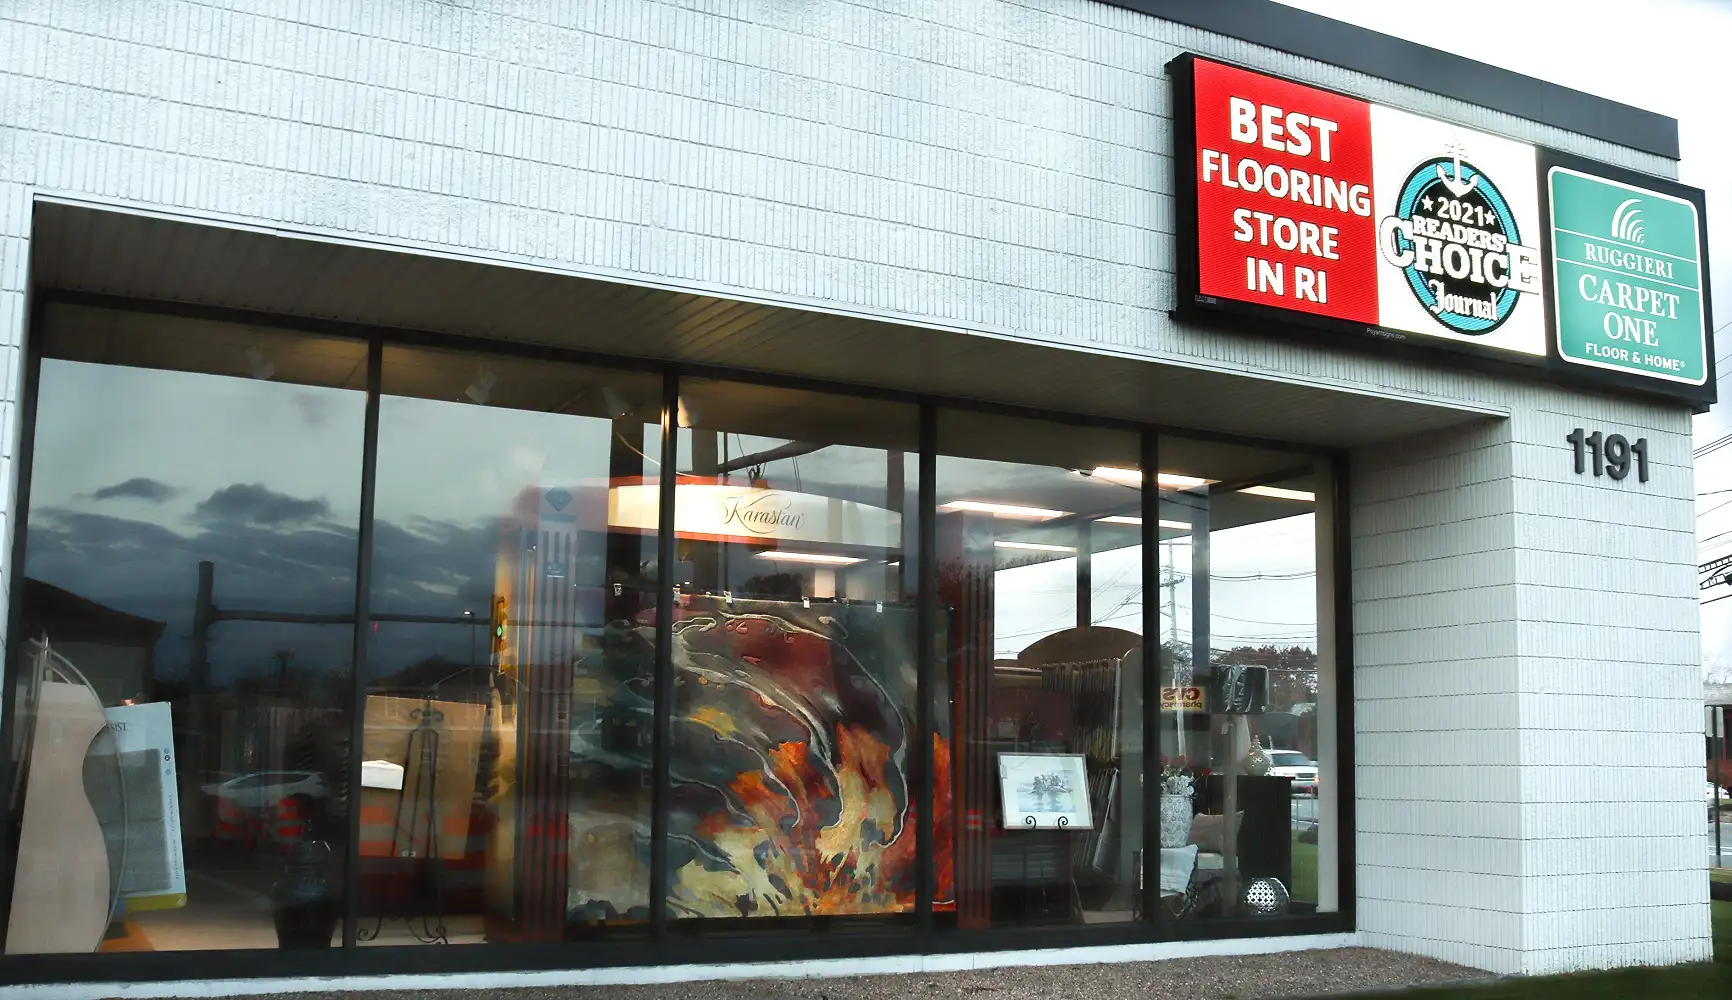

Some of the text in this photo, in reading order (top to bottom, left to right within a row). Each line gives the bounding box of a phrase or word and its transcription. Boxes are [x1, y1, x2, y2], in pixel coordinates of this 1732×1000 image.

[1230, 96, 1338, 162] BEST
[1202, 148, 1371, 217] FLOORING
[1233, 207, 1340, 260] STORE
[1437, 196, 1484, 226] 2021
[1380, 215, 1539, 295] CHOICE
[1584, 243, 1673, 279] RUGGIERI
[1247, 256, 1327, 304] IN RI
[1429, 279, 1499, 321] Journal
[1579, 274, 1680, 319] CARPET
[1603, 312, 1659, 346] ONE
[1586, 342, 1628, 361] FLOOR
[1632, 352, 1641, 363] &
[1566, 428, 1649, 483] 1191
[722, 494, 805, 534] Karastan
